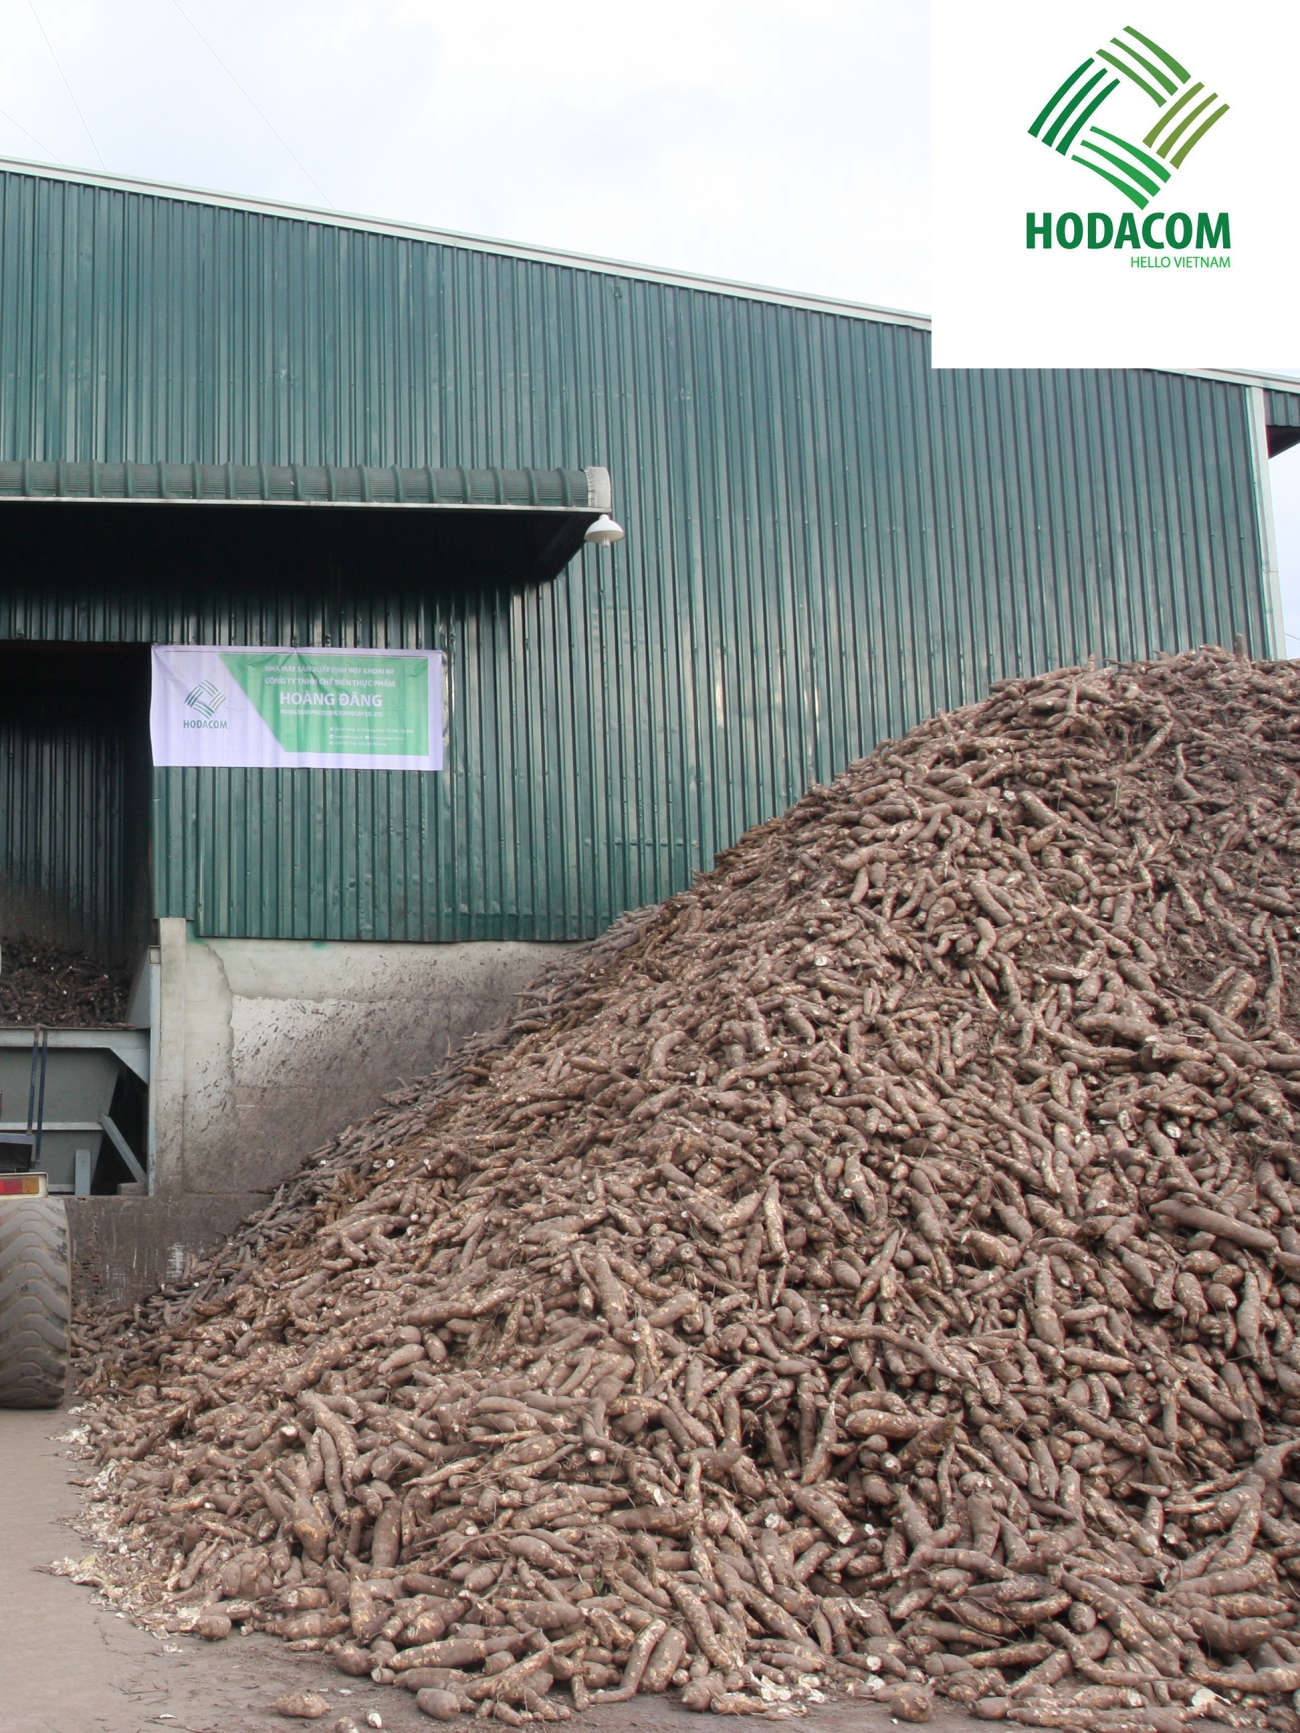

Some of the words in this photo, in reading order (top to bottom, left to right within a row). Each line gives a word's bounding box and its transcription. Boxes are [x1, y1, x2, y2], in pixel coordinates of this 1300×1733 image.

[264, 676, 286, 684] CÔNG
[280, 690, 335, 706] HOÀNG
[338, 691, 382, 707] ĐĂNG
[183, 720, 228, 730] HODACOM
